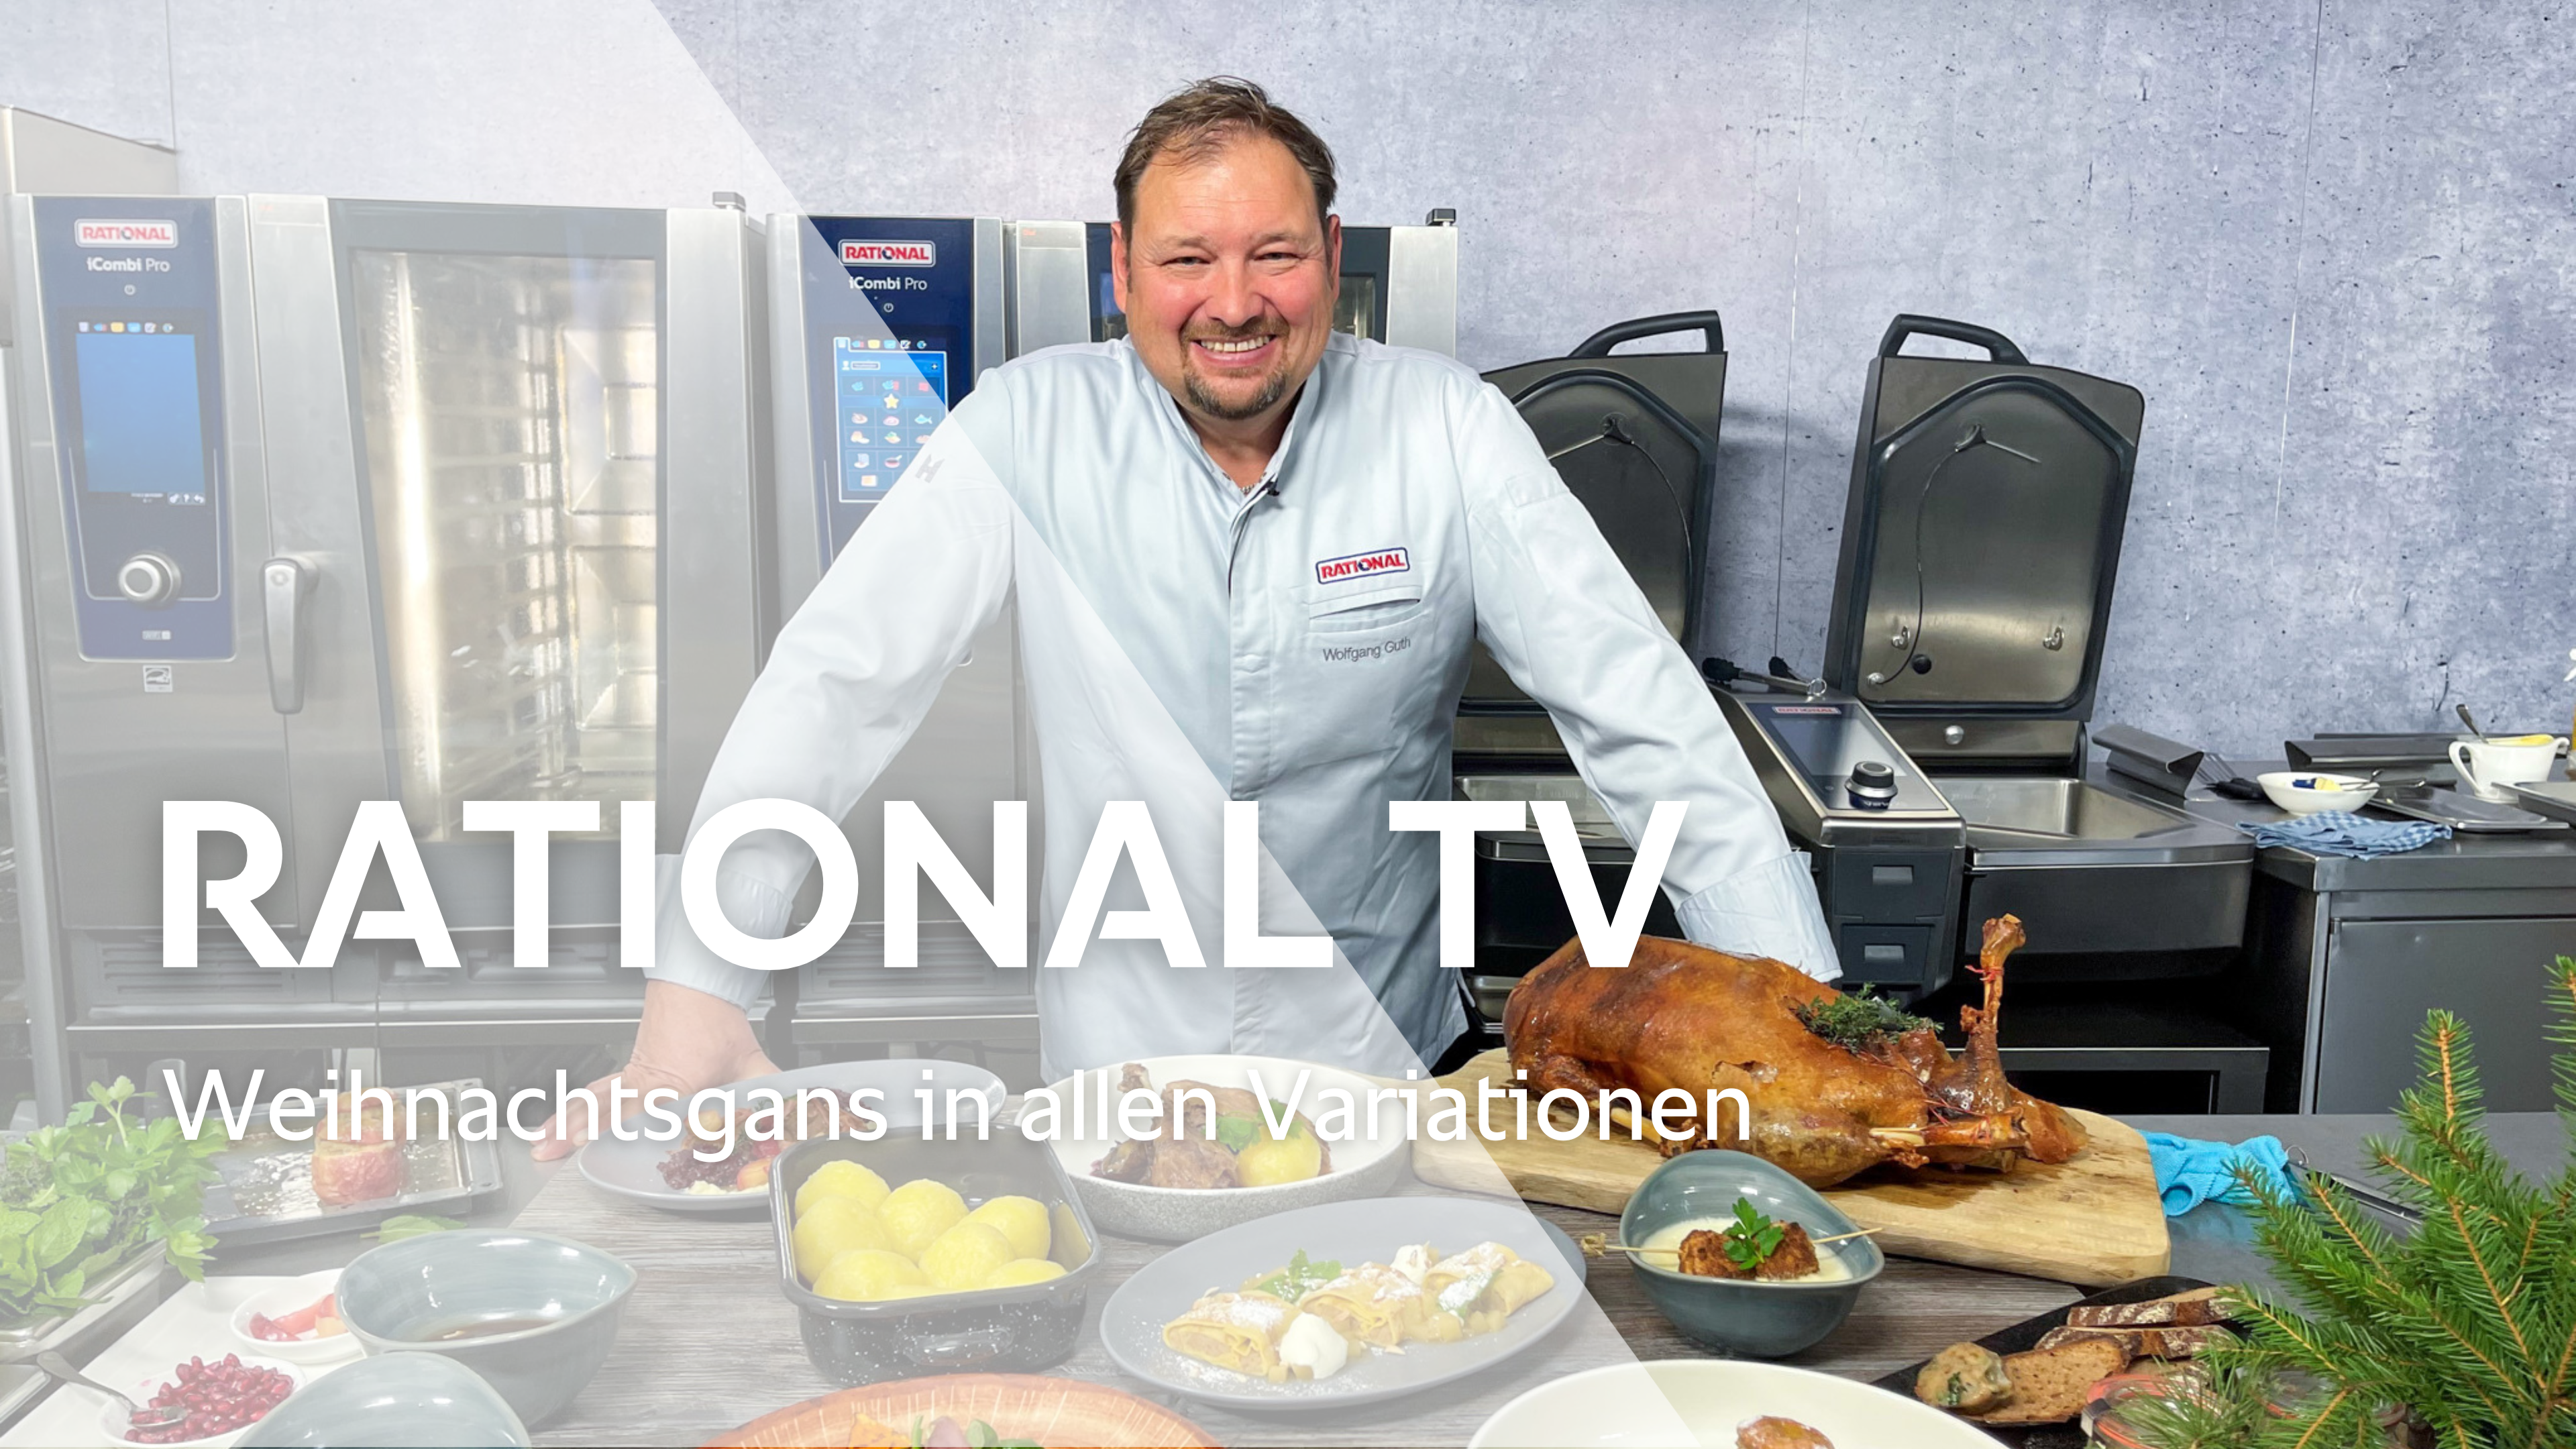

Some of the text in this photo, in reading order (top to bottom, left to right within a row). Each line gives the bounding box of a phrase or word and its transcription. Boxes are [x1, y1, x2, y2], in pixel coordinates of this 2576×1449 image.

[82, 226, 171, 241] RATIONAL
[845, 246, 930, 261] RATIONAL
[87, 257, 171, 272] iCombi Pro
[849, 276, 928, 290] iCombi Pro
[1320, 553, 1406, 580] RATIONAL
[1322, 637, 1411, 663] Wolfgang Guth
